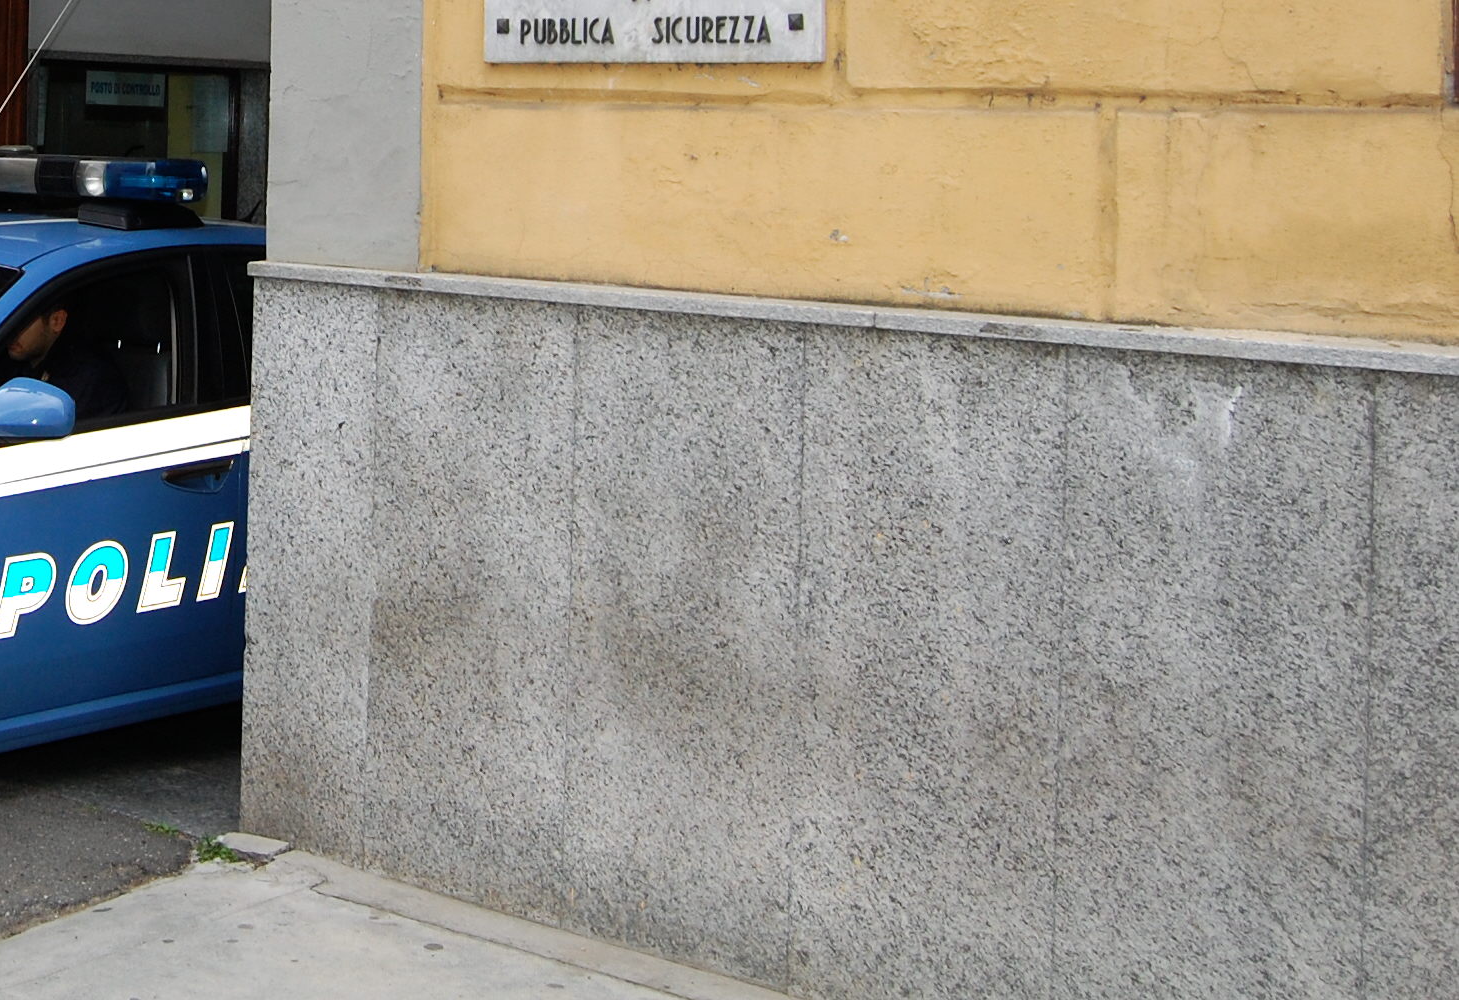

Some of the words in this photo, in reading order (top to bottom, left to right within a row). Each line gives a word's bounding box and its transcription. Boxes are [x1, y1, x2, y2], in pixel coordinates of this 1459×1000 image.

[519, 16, 614, 46] PUBBLICA
[651, 15, 772, 46] SICUREZZA
[90, 81, 112, 95] POSTO
[121, 82, 161, 96] CONTROLLO
